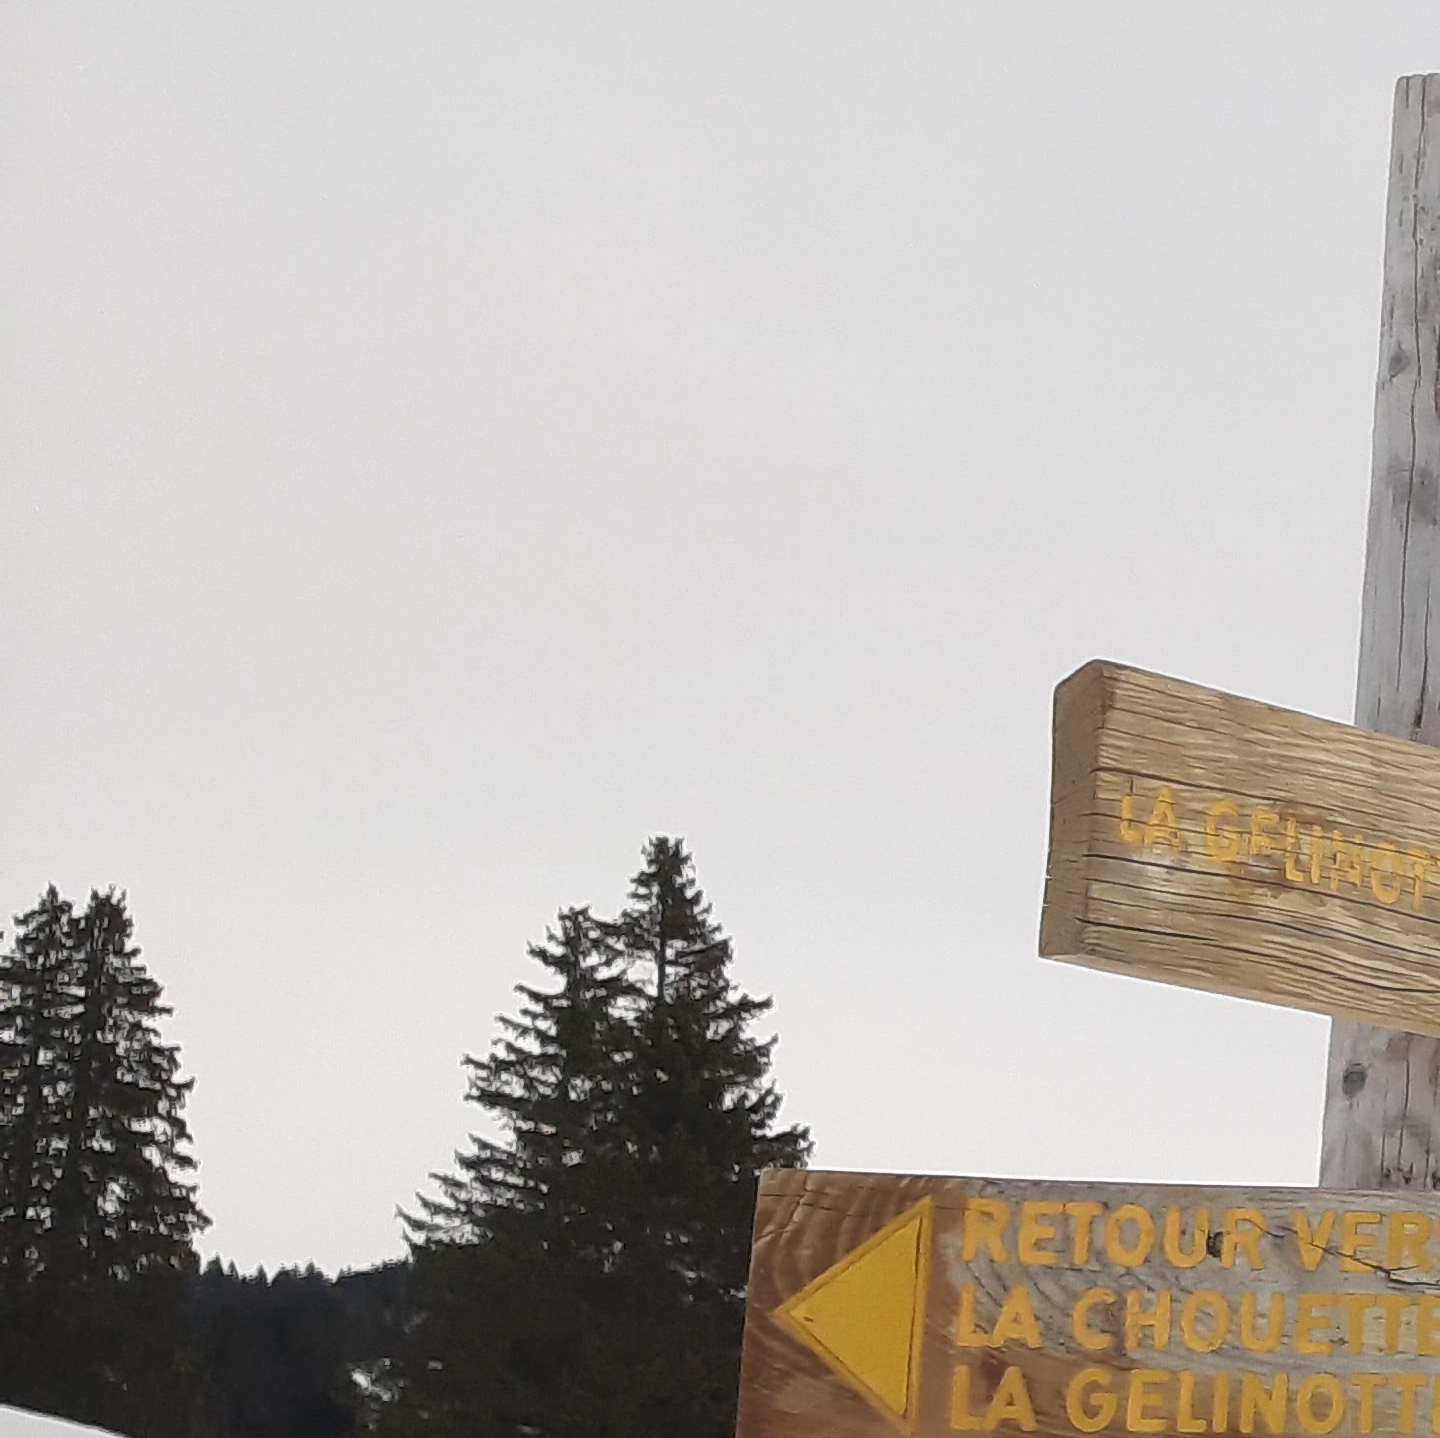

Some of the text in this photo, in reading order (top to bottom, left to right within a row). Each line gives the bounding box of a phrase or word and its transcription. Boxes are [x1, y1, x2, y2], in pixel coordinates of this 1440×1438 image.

[1119, 785, 1184, 853] LA
[961, 1196, 1266, 1271] RETOUR
[955, 1284, 1044, 1349] LA
[950, 1365, 1038, 1433] LA
